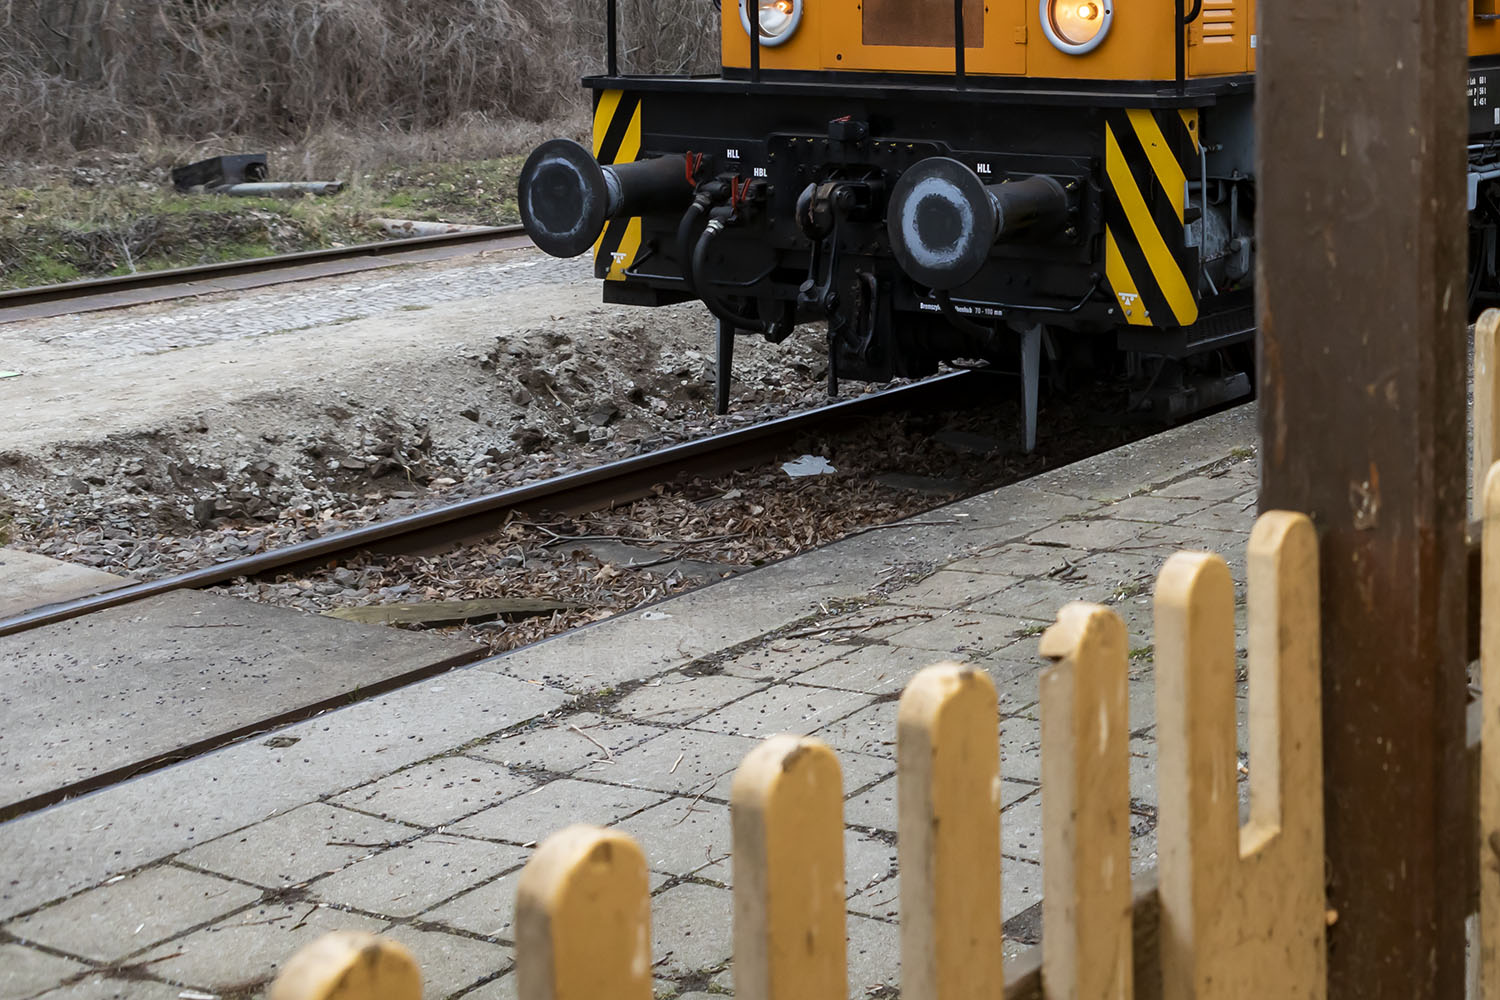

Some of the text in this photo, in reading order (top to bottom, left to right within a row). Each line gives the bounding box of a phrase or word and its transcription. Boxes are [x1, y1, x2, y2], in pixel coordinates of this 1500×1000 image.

[726, 149, 740, 159] HLL
[753, 167, 768, 178] HBL
[977, 163, 992, 174] HLL
